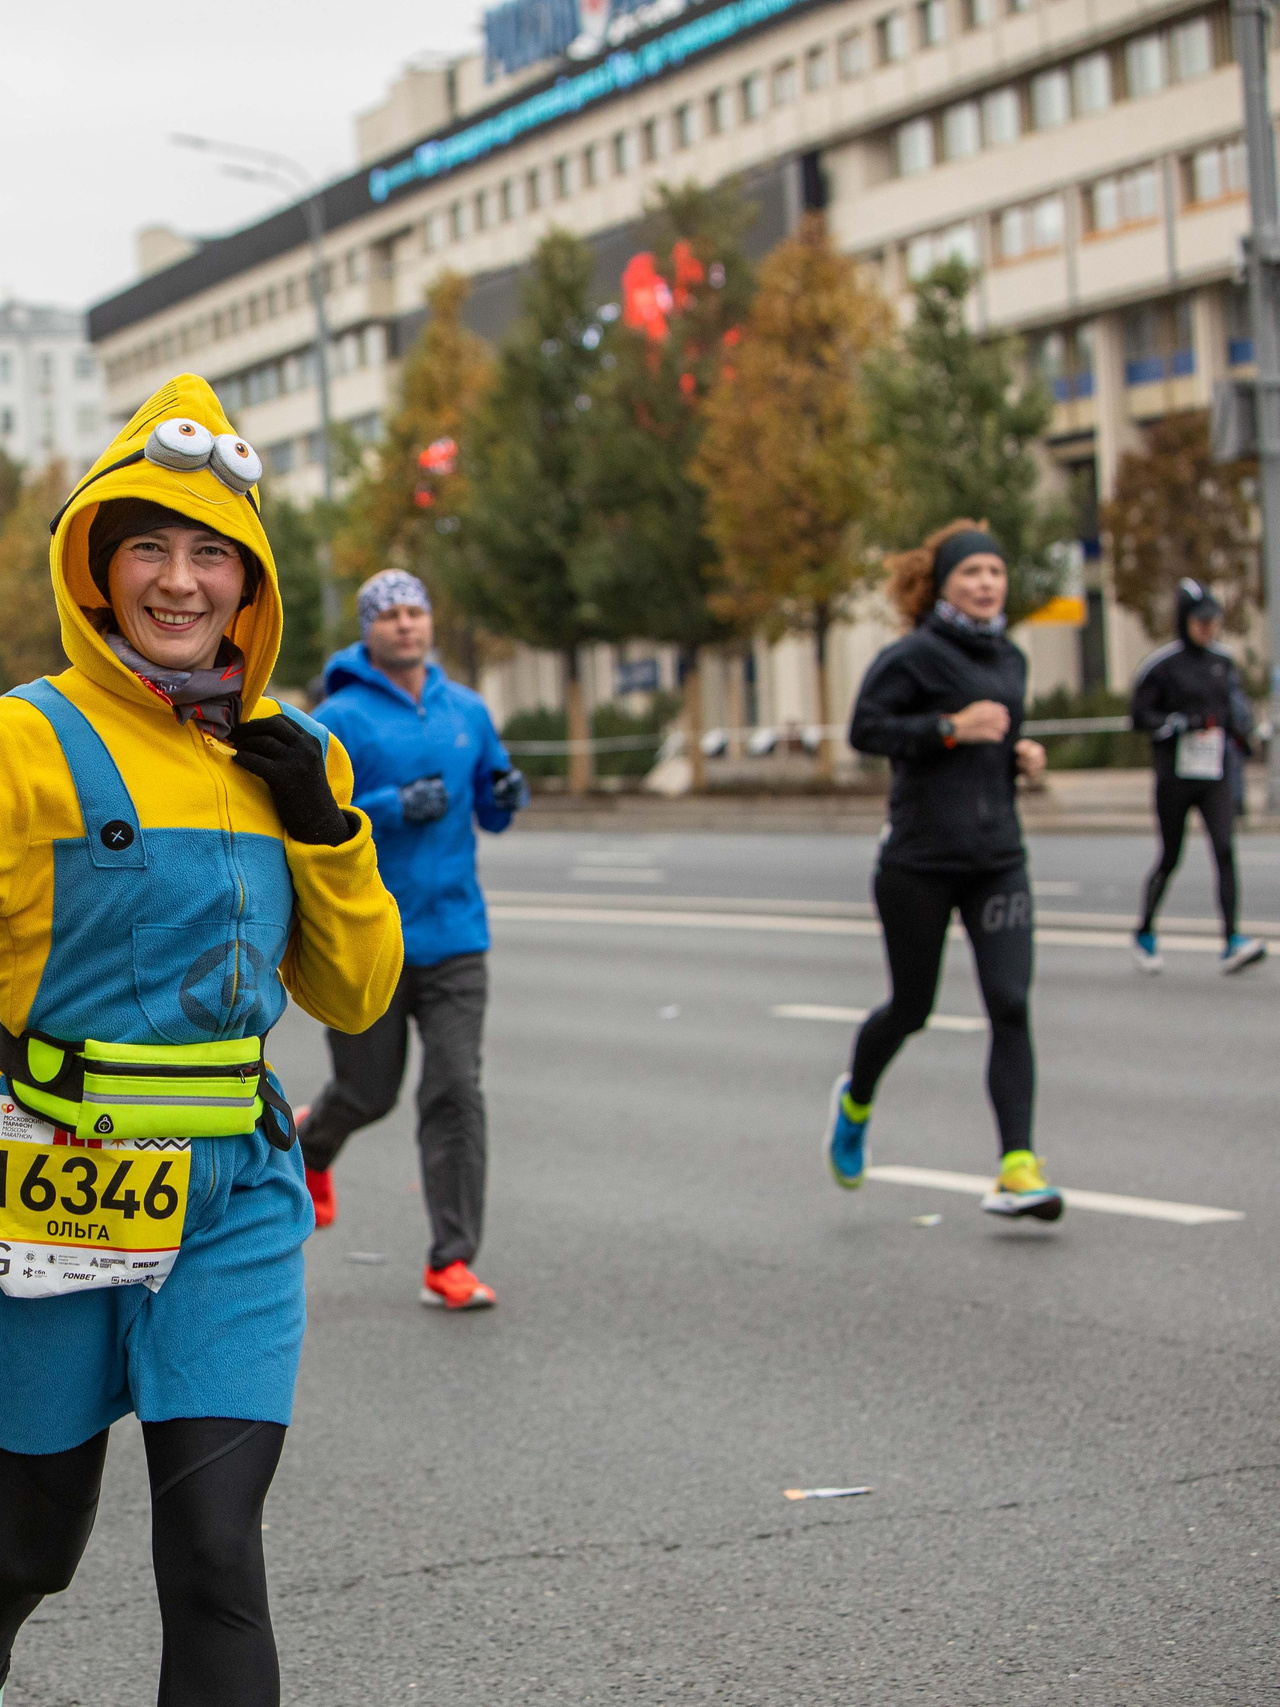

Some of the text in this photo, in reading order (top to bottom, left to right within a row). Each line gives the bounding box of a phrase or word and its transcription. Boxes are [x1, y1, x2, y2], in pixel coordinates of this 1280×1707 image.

[2, 1120, 33, 1129] МАРАФОН
[1, 1126, 28, 1134] MOSCOW
[0, 1131, 33, 1140] MARATHON
[46, 1220, 110, 1241] ОЛЬГА
[132, 1260, 160, 1269] СИБУР
[62, 1272, 97, 1281] FONBET
